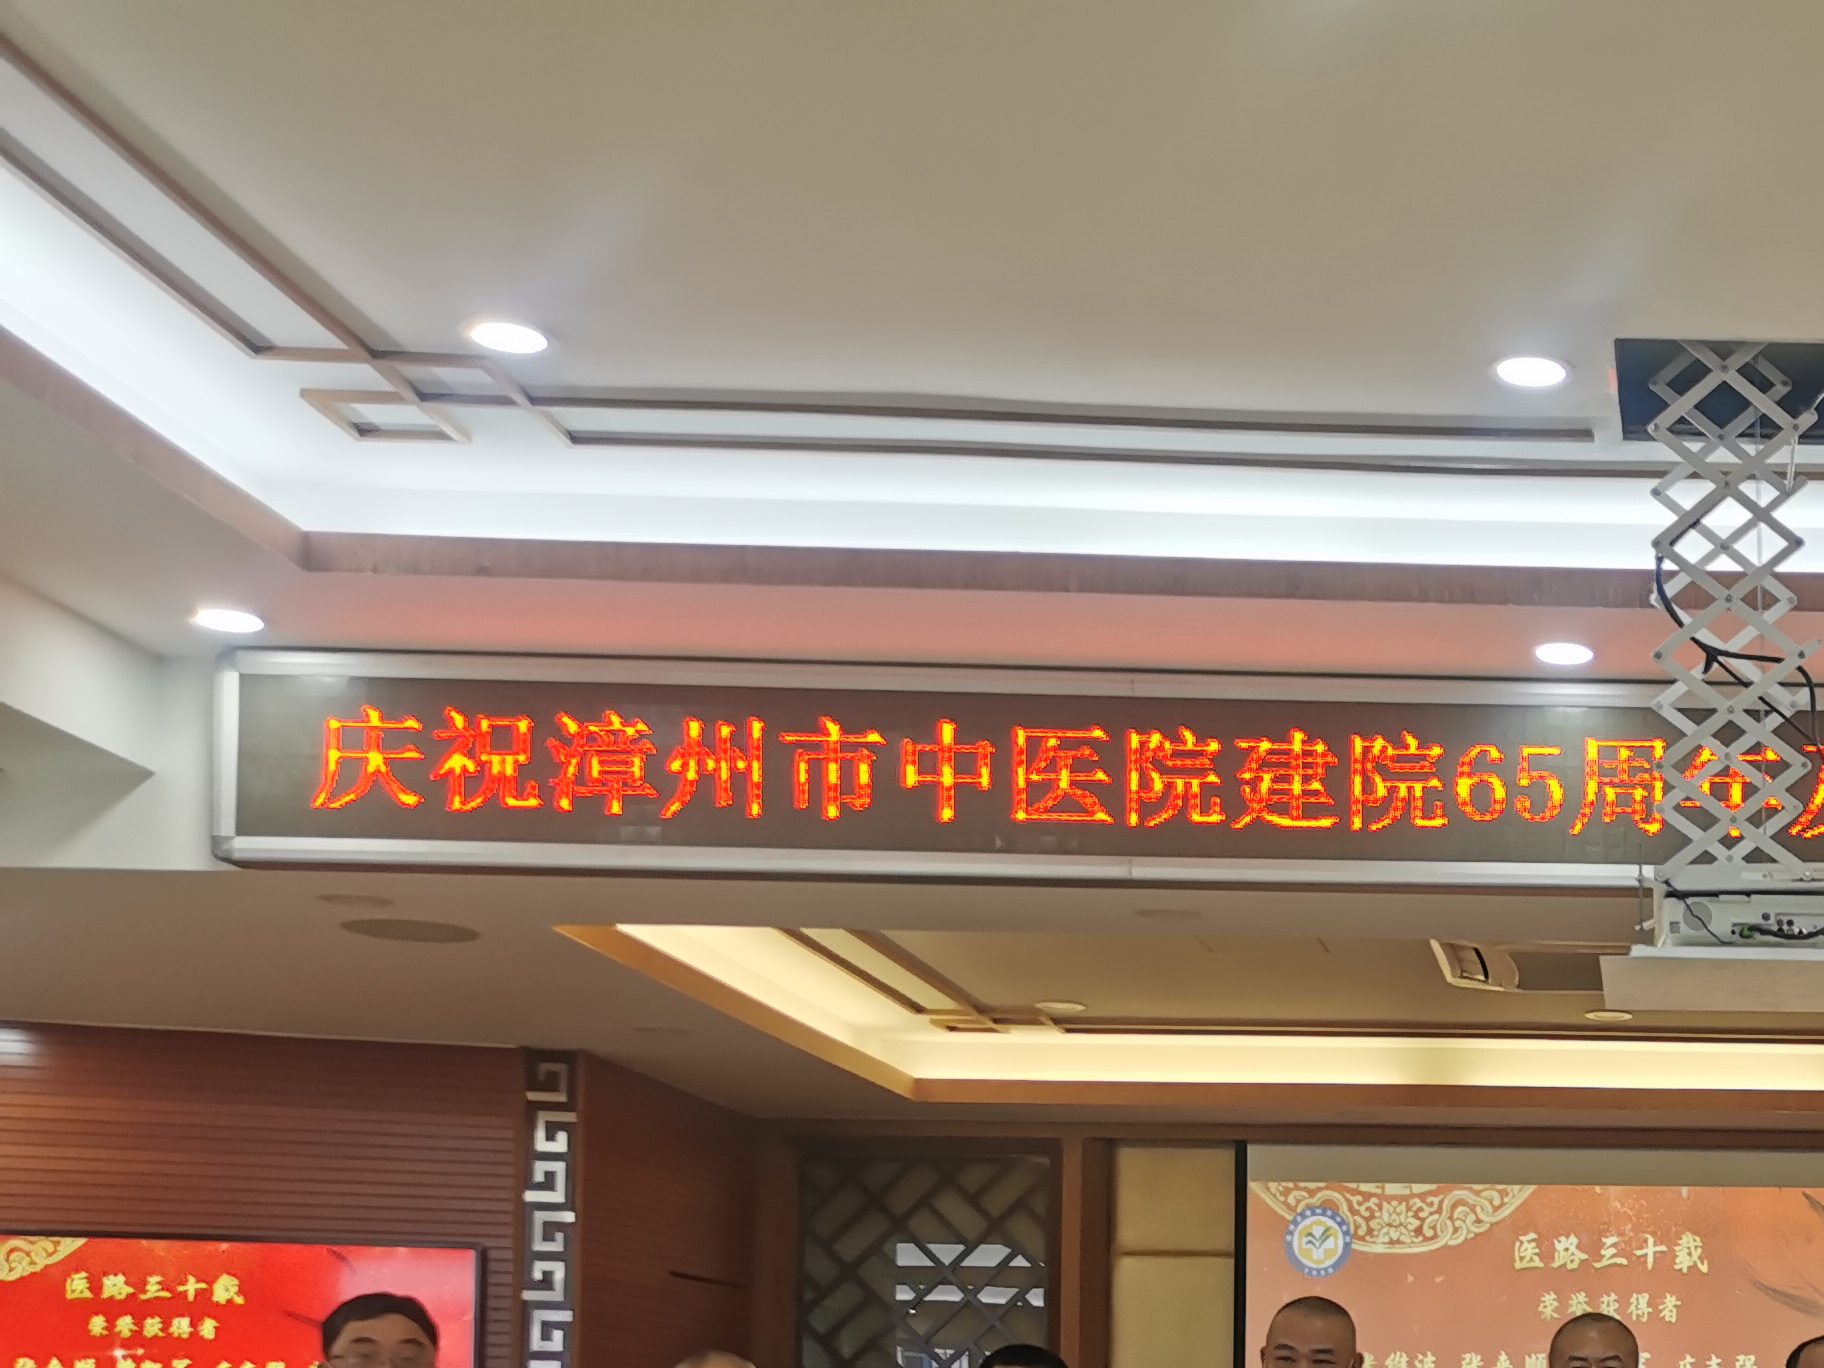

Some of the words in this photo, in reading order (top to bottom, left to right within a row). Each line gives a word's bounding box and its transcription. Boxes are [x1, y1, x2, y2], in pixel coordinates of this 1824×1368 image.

[1513, 1231, 1710, 1274] 医路三十载
[65, 1270, 246, 1305] 医路三十载
